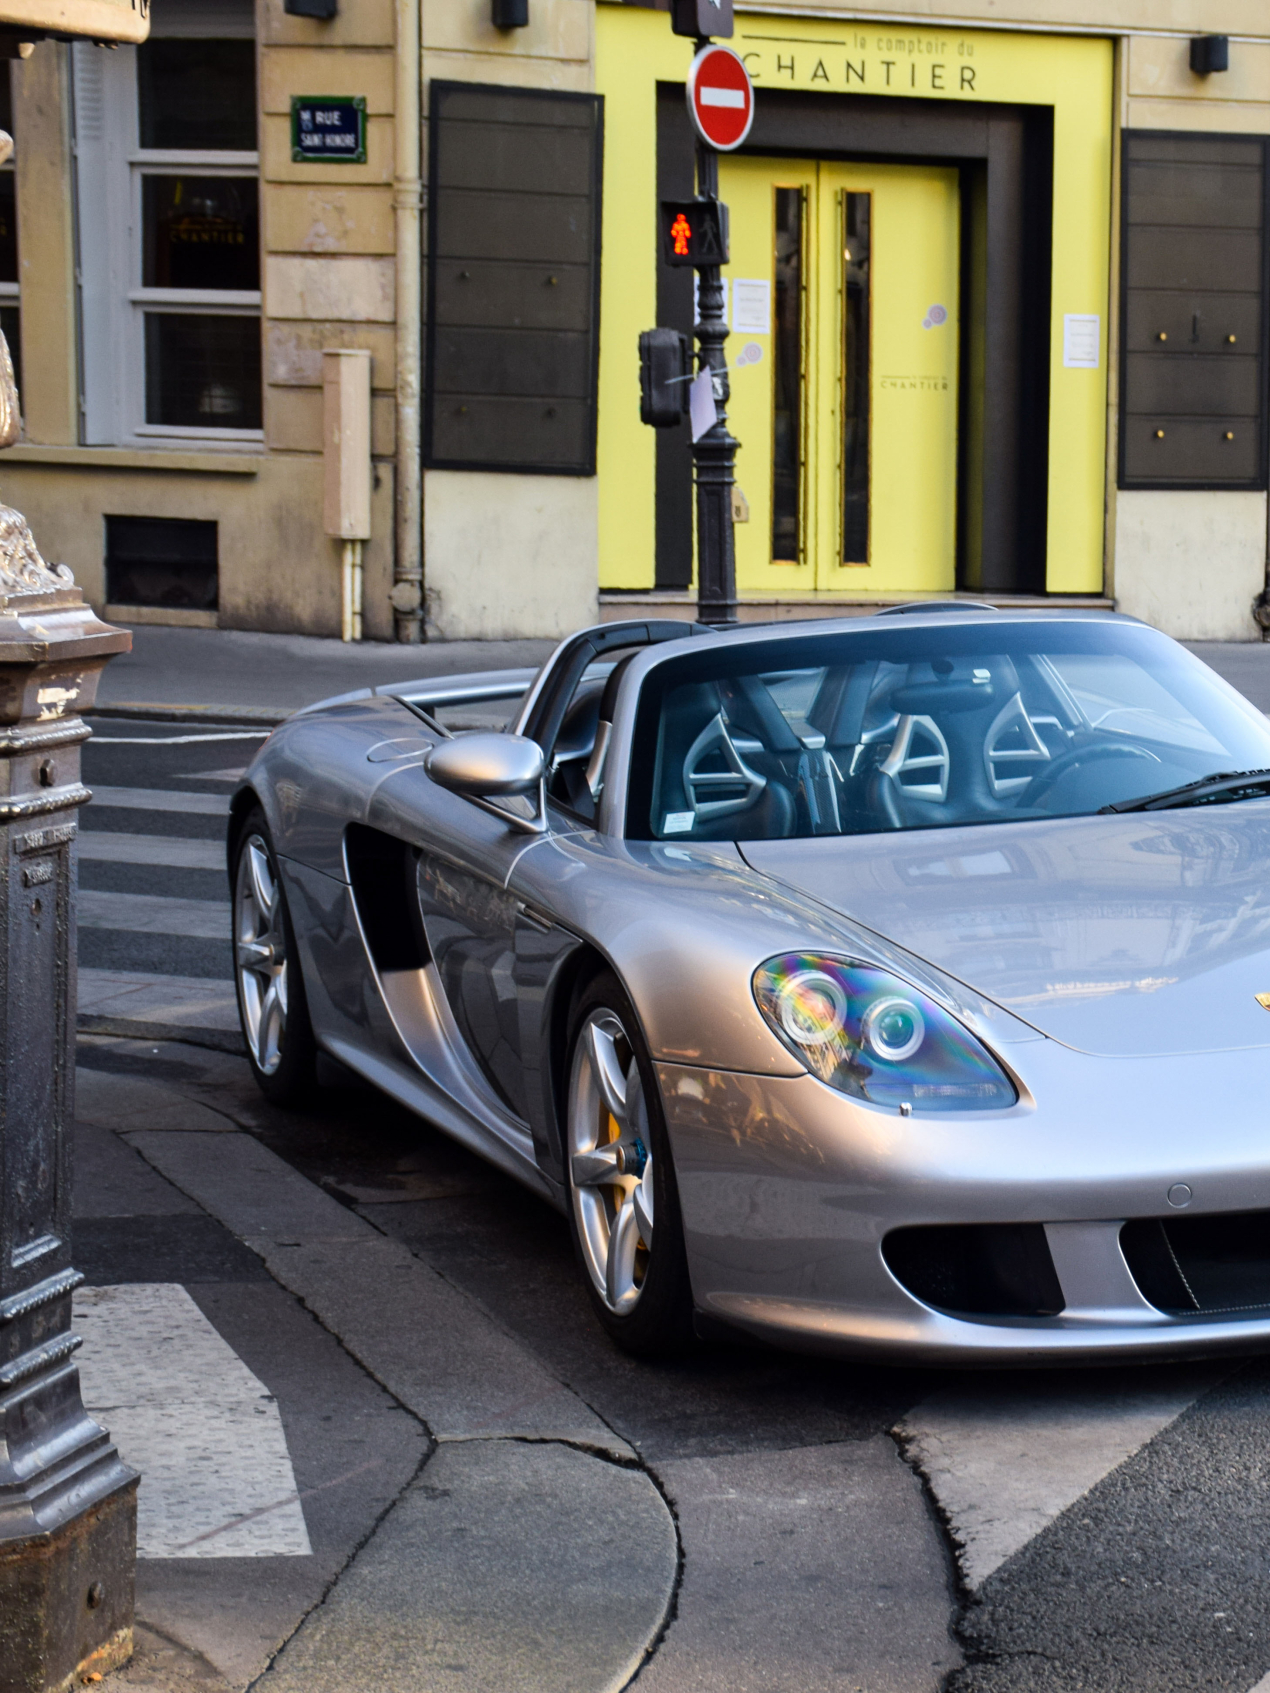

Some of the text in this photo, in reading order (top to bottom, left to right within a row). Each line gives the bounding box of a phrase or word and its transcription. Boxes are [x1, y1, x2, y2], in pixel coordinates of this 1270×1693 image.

[853, 32, 975, 57] le comptoir du
[743, 52, 976, 92] CHANTIER
[315, 110, 342, 126] RUE
